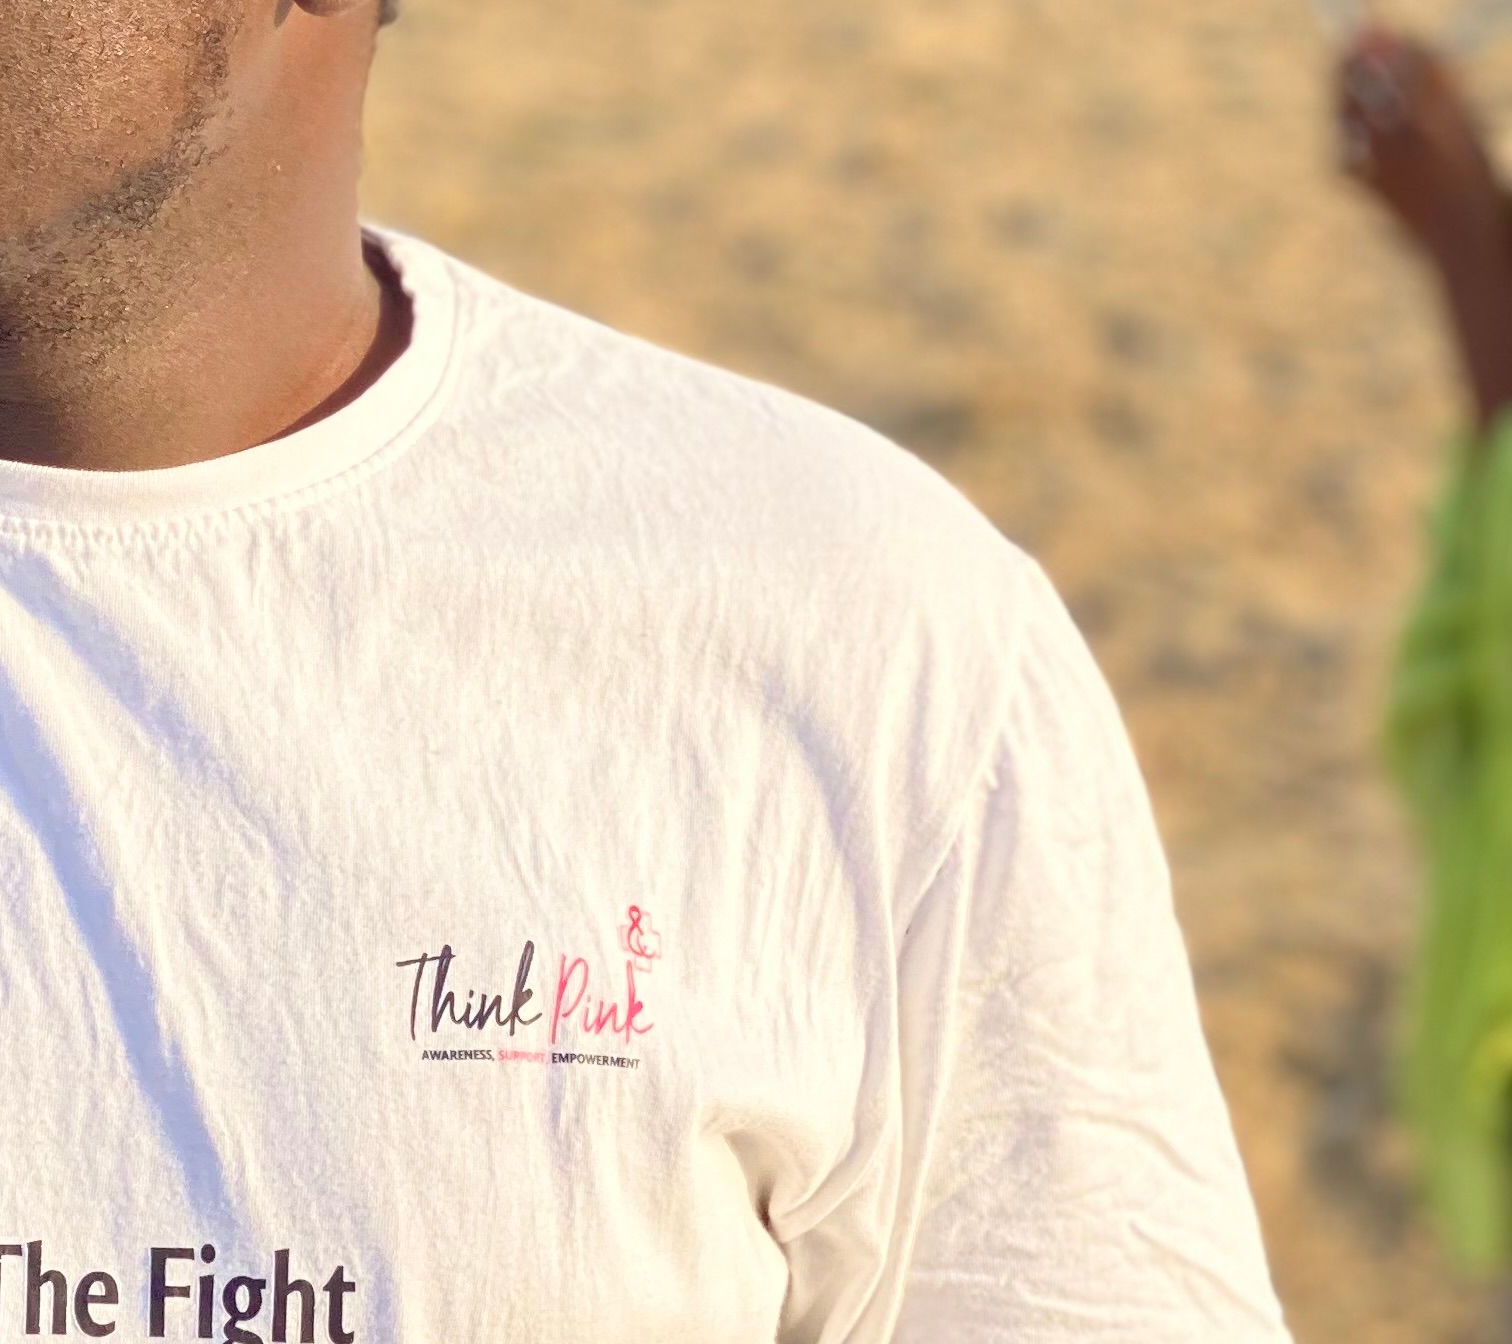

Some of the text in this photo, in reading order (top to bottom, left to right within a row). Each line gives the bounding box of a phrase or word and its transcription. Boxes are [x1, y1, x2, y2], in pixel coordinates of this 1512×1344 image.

[396, 941, 654, 1044] Think Pink
[551, 1052, 640, 1069] EMPOWERMENT
